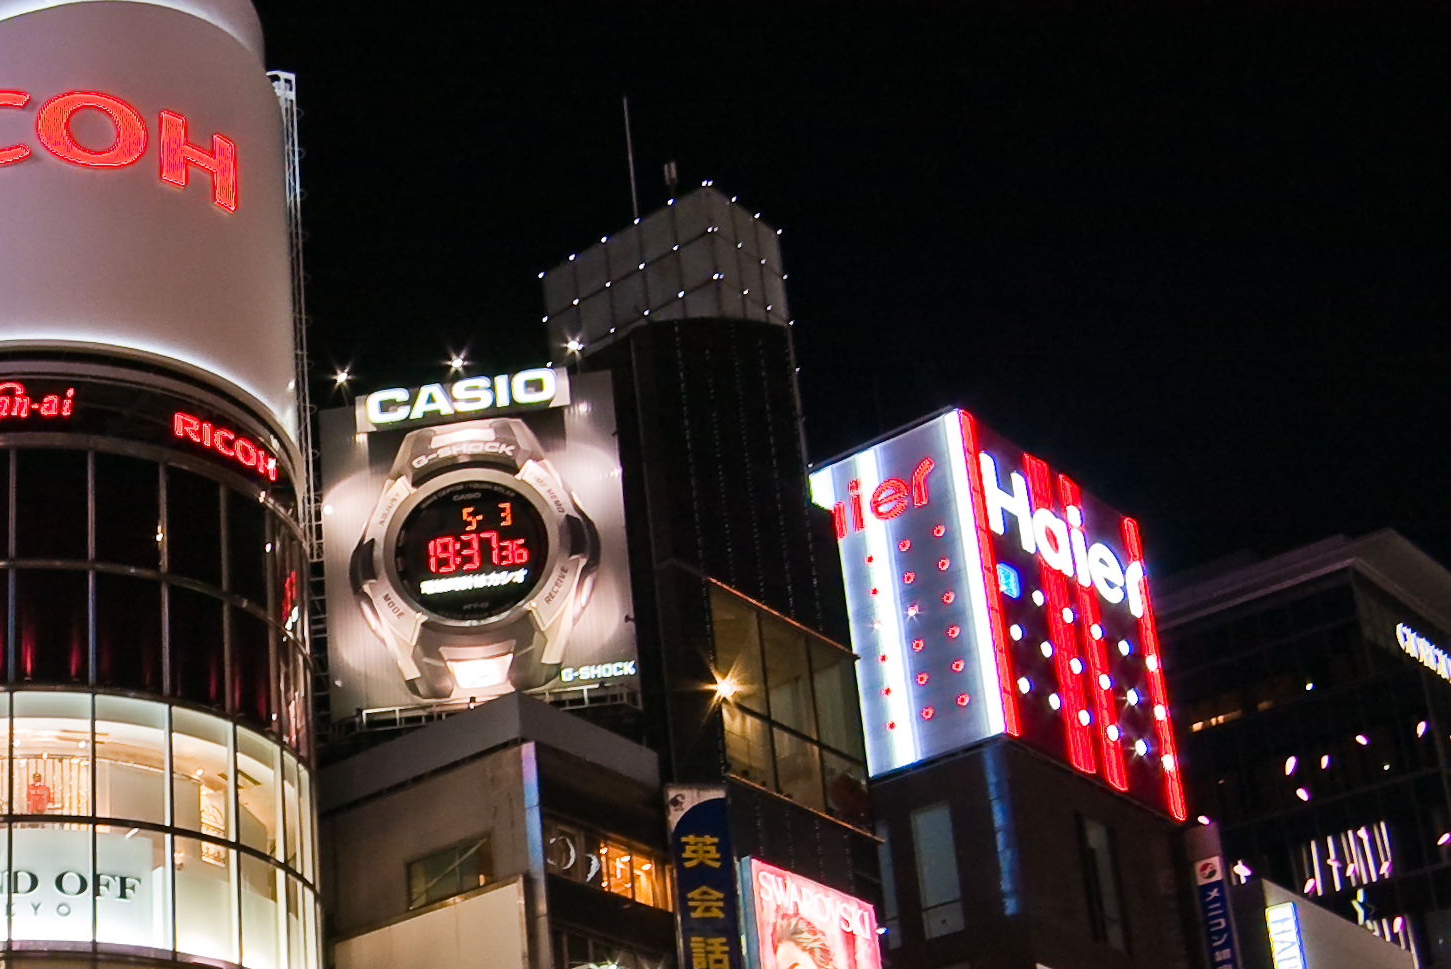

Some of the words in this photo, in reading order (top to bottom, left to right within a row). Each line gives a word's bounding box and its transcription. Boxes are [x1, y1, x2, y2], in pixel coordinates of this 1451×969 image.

[366, 367, 557, 424] CASIO
[173, 411, 278, 481] RICOH
[411, 441, 516, 470] G-SHOCK
[979, 450, 1146, 619] Haier
[544, 565, 568, 604] RECEIVE
[560, 659, 636, 681] G-SHOCK
[55, 871, 142, 900] OFF
[757, 869, 872, 941] SWAROVSKI
